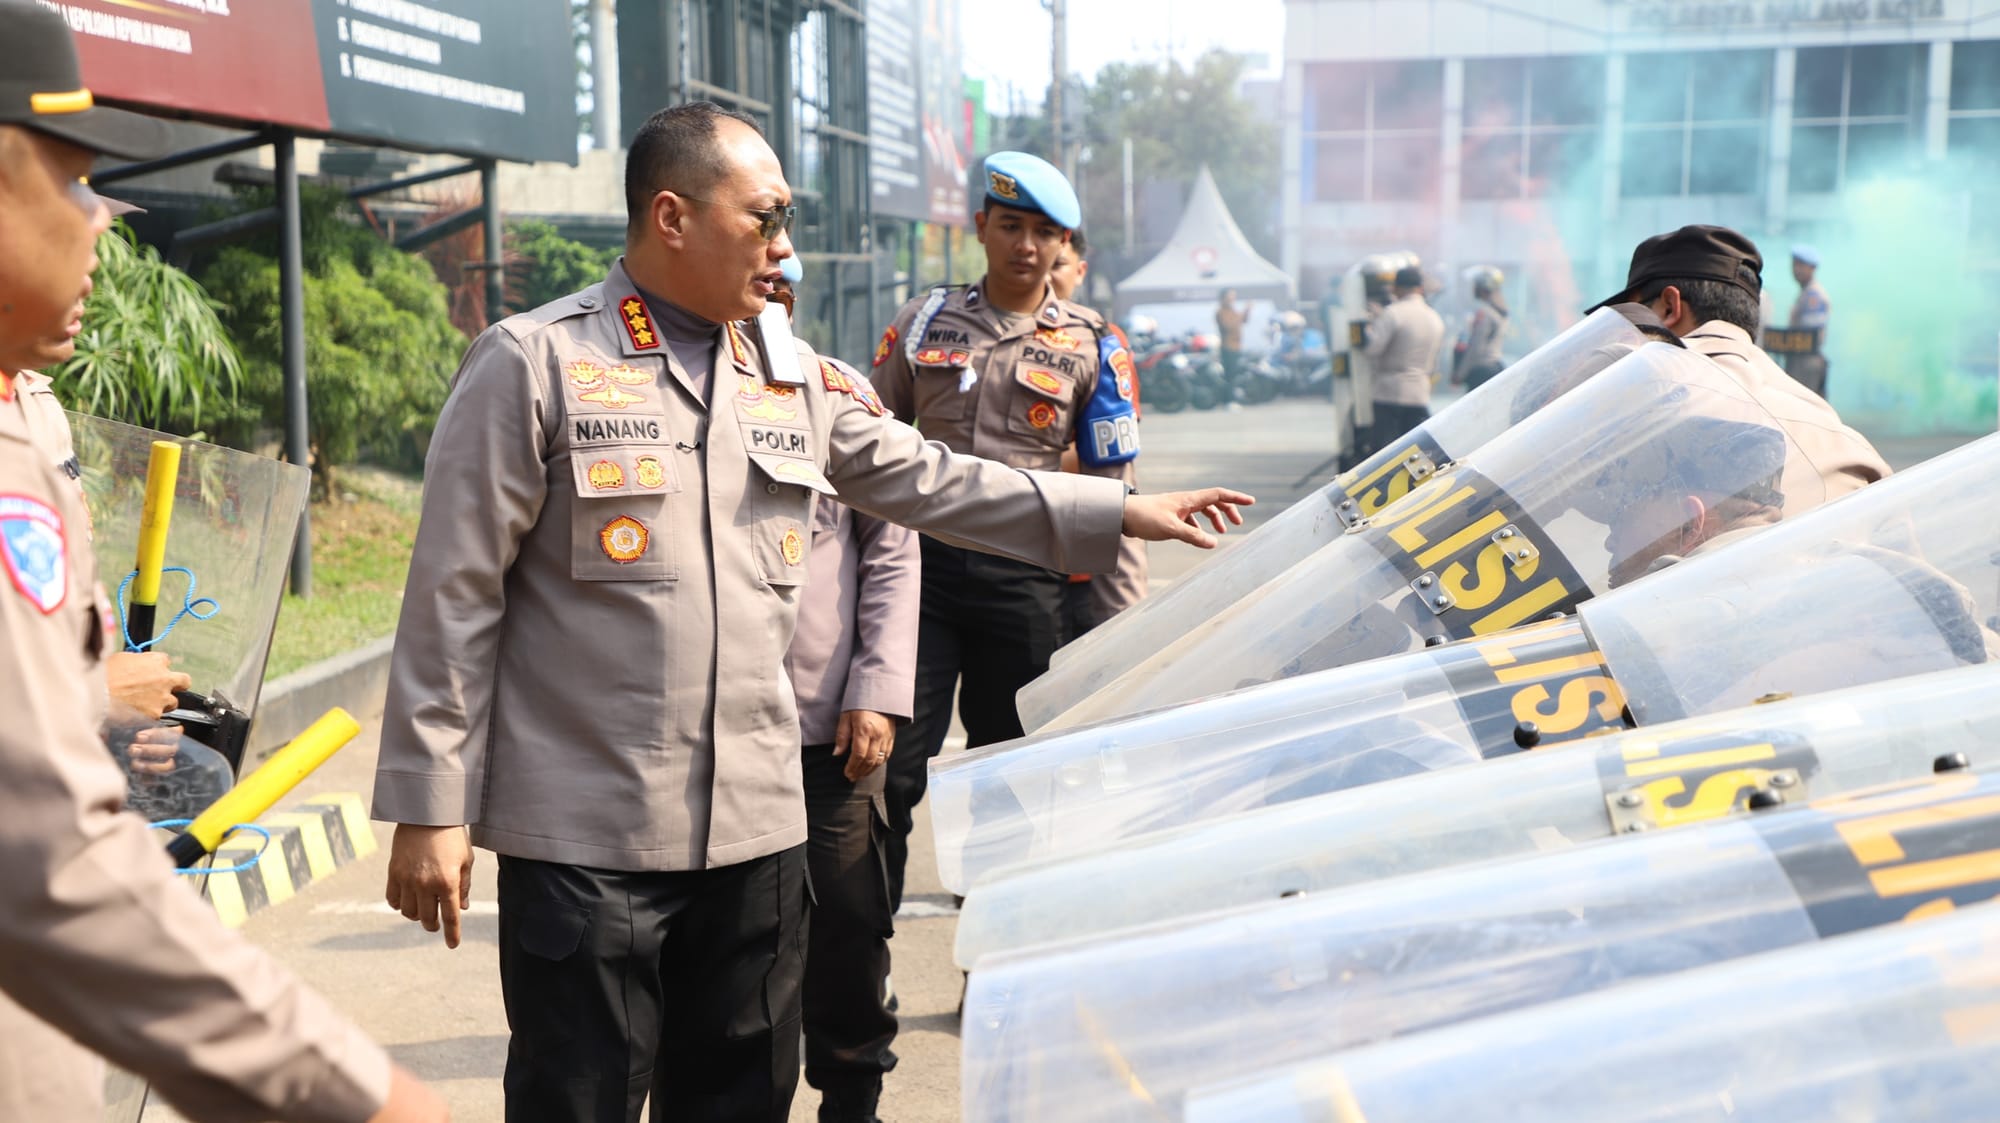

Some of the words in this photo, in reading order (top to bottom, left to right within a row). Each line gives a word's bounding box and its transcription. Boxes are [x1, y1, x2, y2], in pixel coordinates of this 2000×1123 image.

[928, 329, 970, 345] WIRA
[1022, 346, 1076, 375] POLRI
[576, 419, 661, 442] NANANG
[752, 428, 806, 454] POLRI
